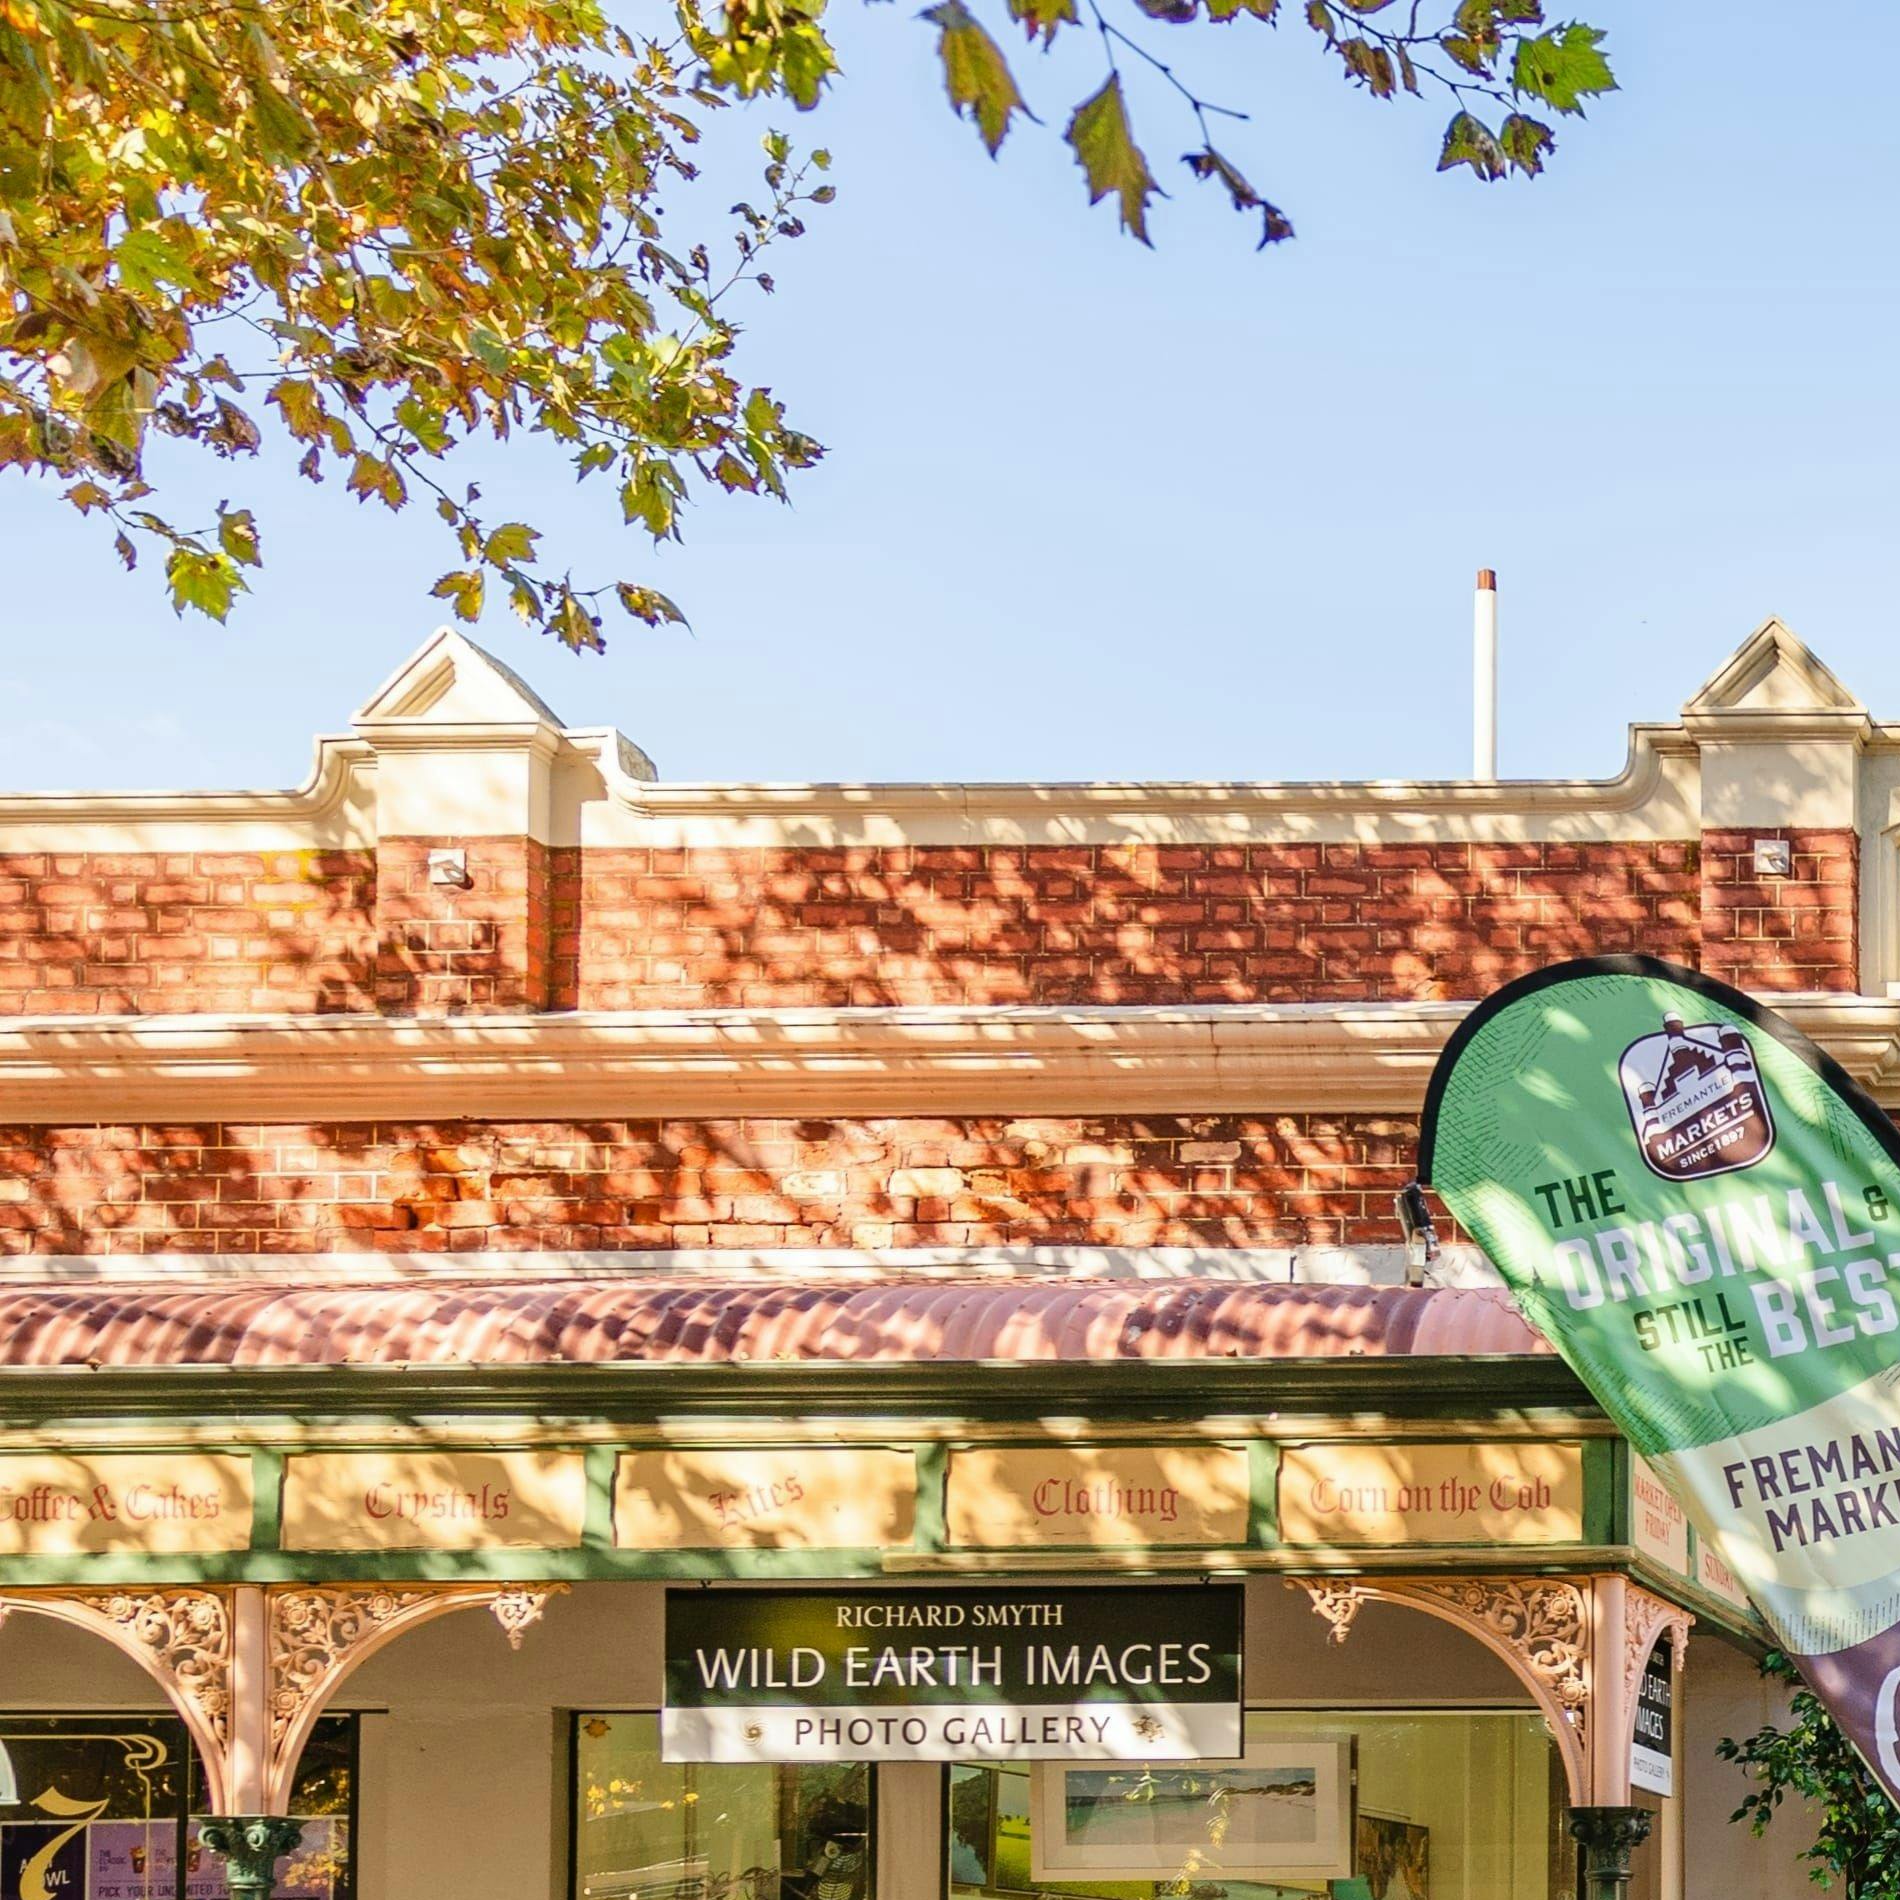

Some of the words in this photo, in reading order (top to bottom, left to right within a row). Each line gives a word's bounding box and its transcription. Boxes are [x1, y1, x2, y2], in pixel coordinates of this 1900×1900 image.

[1661, 1074, 1730, 1123] FREMANTLE
[1656, 1092, 1753, 1161] MARKETS
[1680, 1143, 1715, 1168] SINCE
[1714, 1127, 1745, 1151] 1897
[1534, 1169, 1626, 1228] THE
[1553, 1181, 1875, 1311] ORIGINAL
[1862, 1185, 1889, 1222] &
[1633, 1292, 1746, 1352] STILL
[1697, 1336, 1755, 1374] THE
[87, 1484, 118, 1523] &
[125, 1483, 222, 1522] Cakes
[364, 1481, 512, 1528] Crystals
[708, 1472, 804, 1533] Kites
[1032, 1477, 1179, 1523] Clothing
[1309, 1477, 1388, 1515] Corn
[1398, 1484, 1433, 1514] on
[1439, 1476, 1482, 1520] the
[1489, 1473, 1552, 1513] Cob
[836, 1605, 966, 1628] RICHARD
[972, 1604, 1064, 1627] SMYTH
[696, 1647, 826, 1690] WILD
[845, 1645, 1003, 1688] EARTH
[1027, 1643, 1212, 1687] IMAGES
[795, 1717, 927, 1746] PHOTO
[942, 1715, 1112, 1745] GALLERY
[99, 1886, 120, 1897] PICK
[128, 1886, 154, 1896] YOUR
